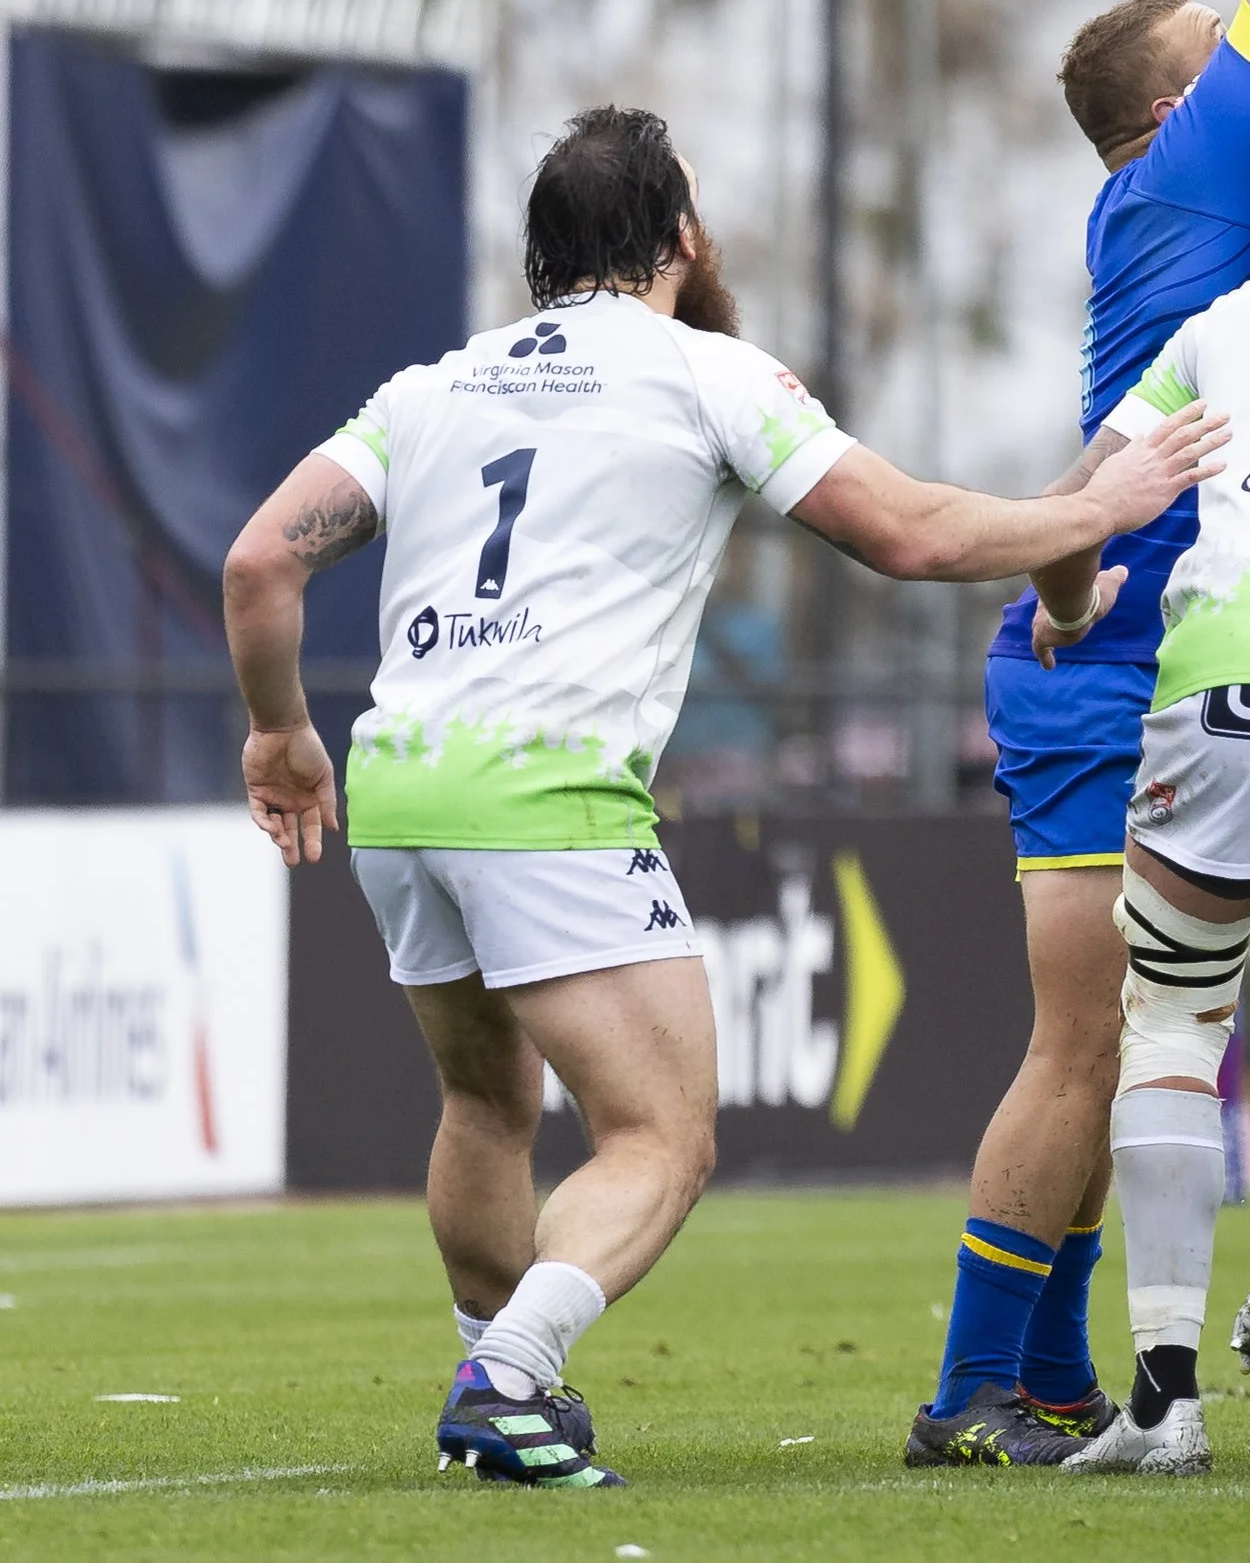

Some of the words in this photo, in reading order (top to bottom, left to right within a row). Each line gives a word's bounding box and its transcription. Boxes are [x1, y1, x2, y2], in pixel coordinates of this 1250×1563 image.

[534, 361, 594, 376] Mason
[450, 380, 537, 395] Fanciscan
[541, 379, 602, 394] Health
[475, 448, 537, 599] 1
[444, 607, 542, 650] Tukwila
